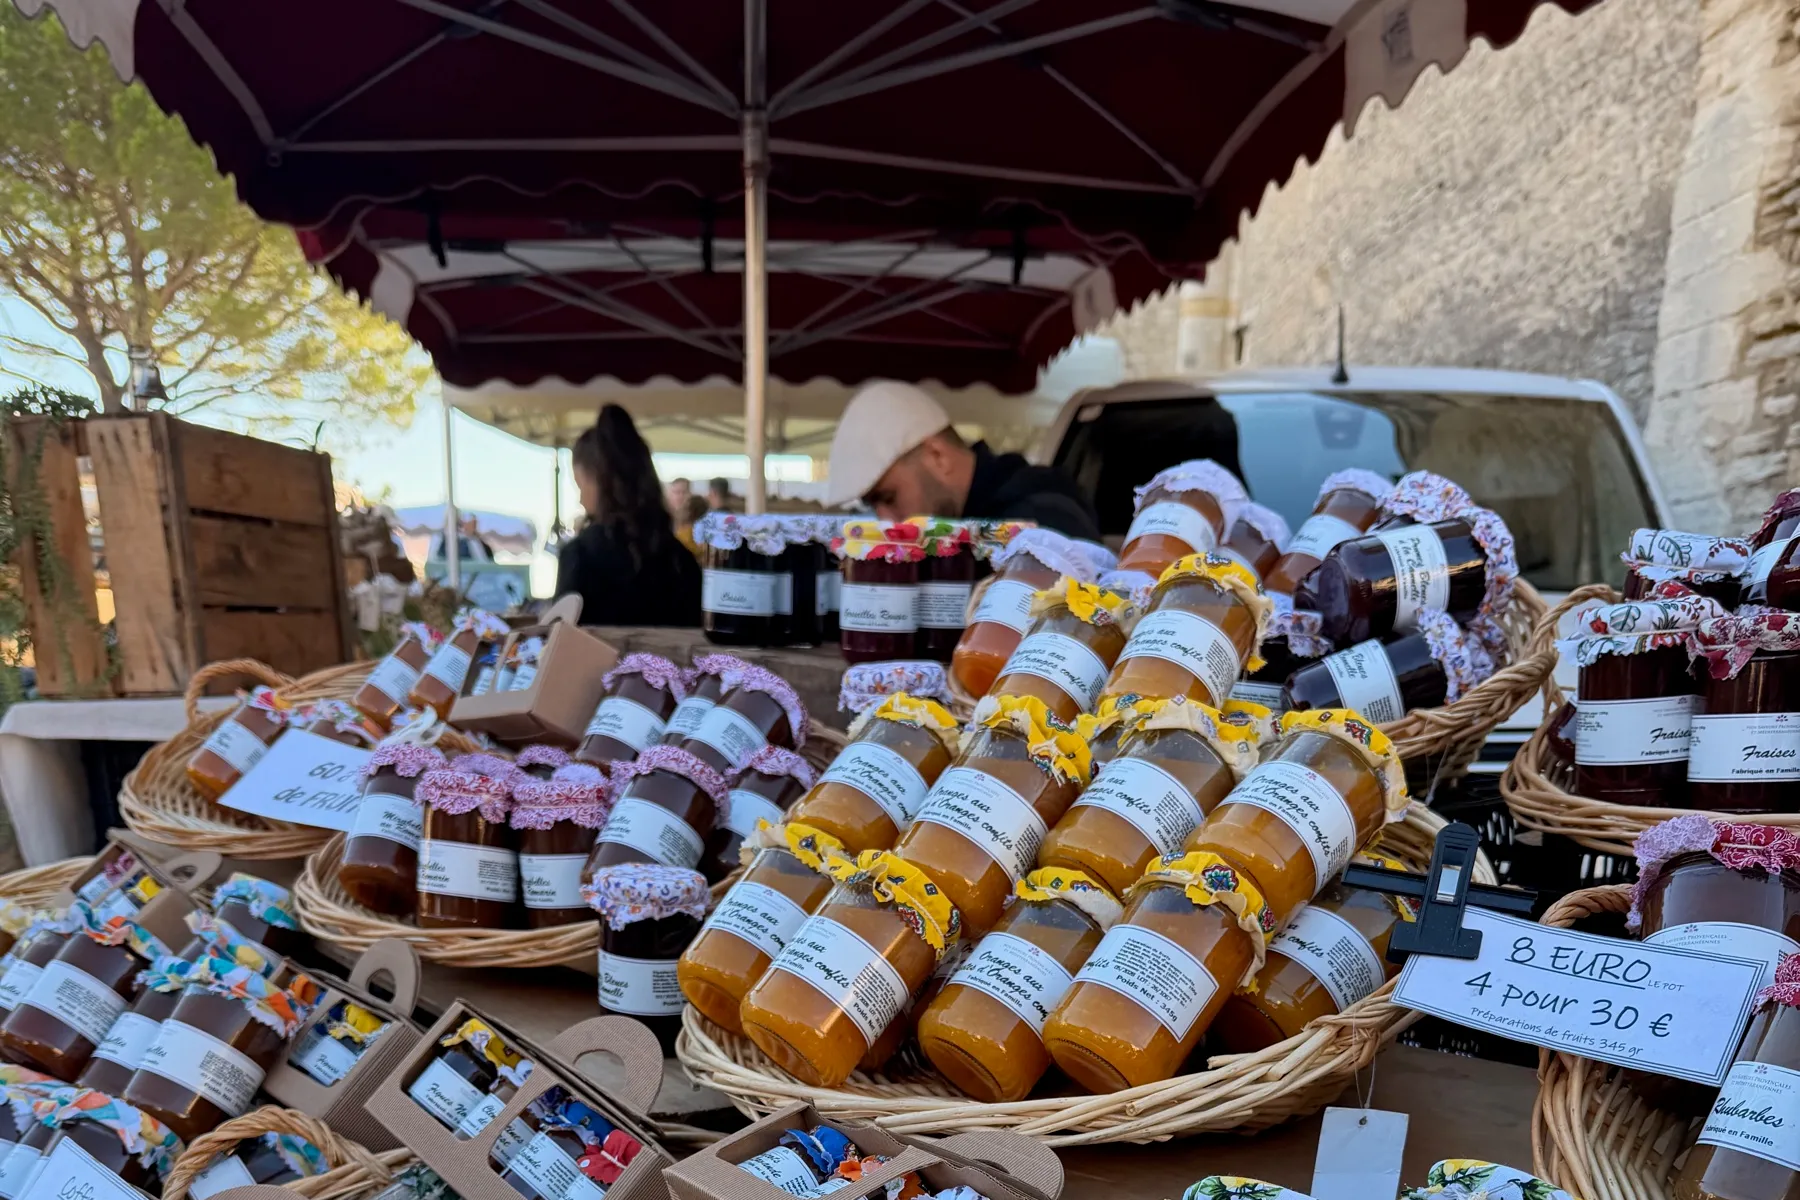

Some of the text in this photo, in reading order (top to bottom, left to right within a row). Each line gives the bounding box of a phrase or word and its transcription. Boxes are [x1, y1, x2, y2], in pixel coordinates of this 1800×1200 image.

[1157, 628, 1177, 636] aux
[1047, 652, 1067, 662] aux
[1170, 642, 1204, 662] confits
[1060, 668, 1087, 693] confits
[1742, 745, 1796, 762] Fraises
[308, 762, 345, 780] 60
[849, 756, 906, 795] Oranges aux
[1106, 777, 1127, 785] aux
[273, 786, 306, 804] de
[850, 767, 897, 801] d'Oranges
[1252, 775, 1320, 812] Oranges aux
[971, 799, 992, 814] aux
[1115, 792, 1152, 815] confits
[1253, 784, 1331, 857] d'Oranges confits
[981, 822, 1013, 851] confits
[760, 912, 779, 925] aux
[807, 941, 827, 953] aux
[1288, 936, 1324, 958] confits
[815, 961, 850, 988] confits
[979, 950, 1044, 991] Oranges aux
[1510, 937, 1684, 992] 8 EURO LE POT
[967, 974, 991, 986] Fabriqué
[1001, 989, 1023, 1007] Famille
[977, 965, 1031, 1000] d'Oranges
[1116, 974, 1178, 1022] Poids Net 345g
[1464, 971, 1673, 1038] 4 pour 30 €
[853, 1002, 869, 1021] Poids
[1471, 1007, 1644, 1058] Préparations de fruits 345 gr
[1713, 1097, 1784, 1128] Rhubarbes
[1740, 1131, 1774, 1146] Famille
